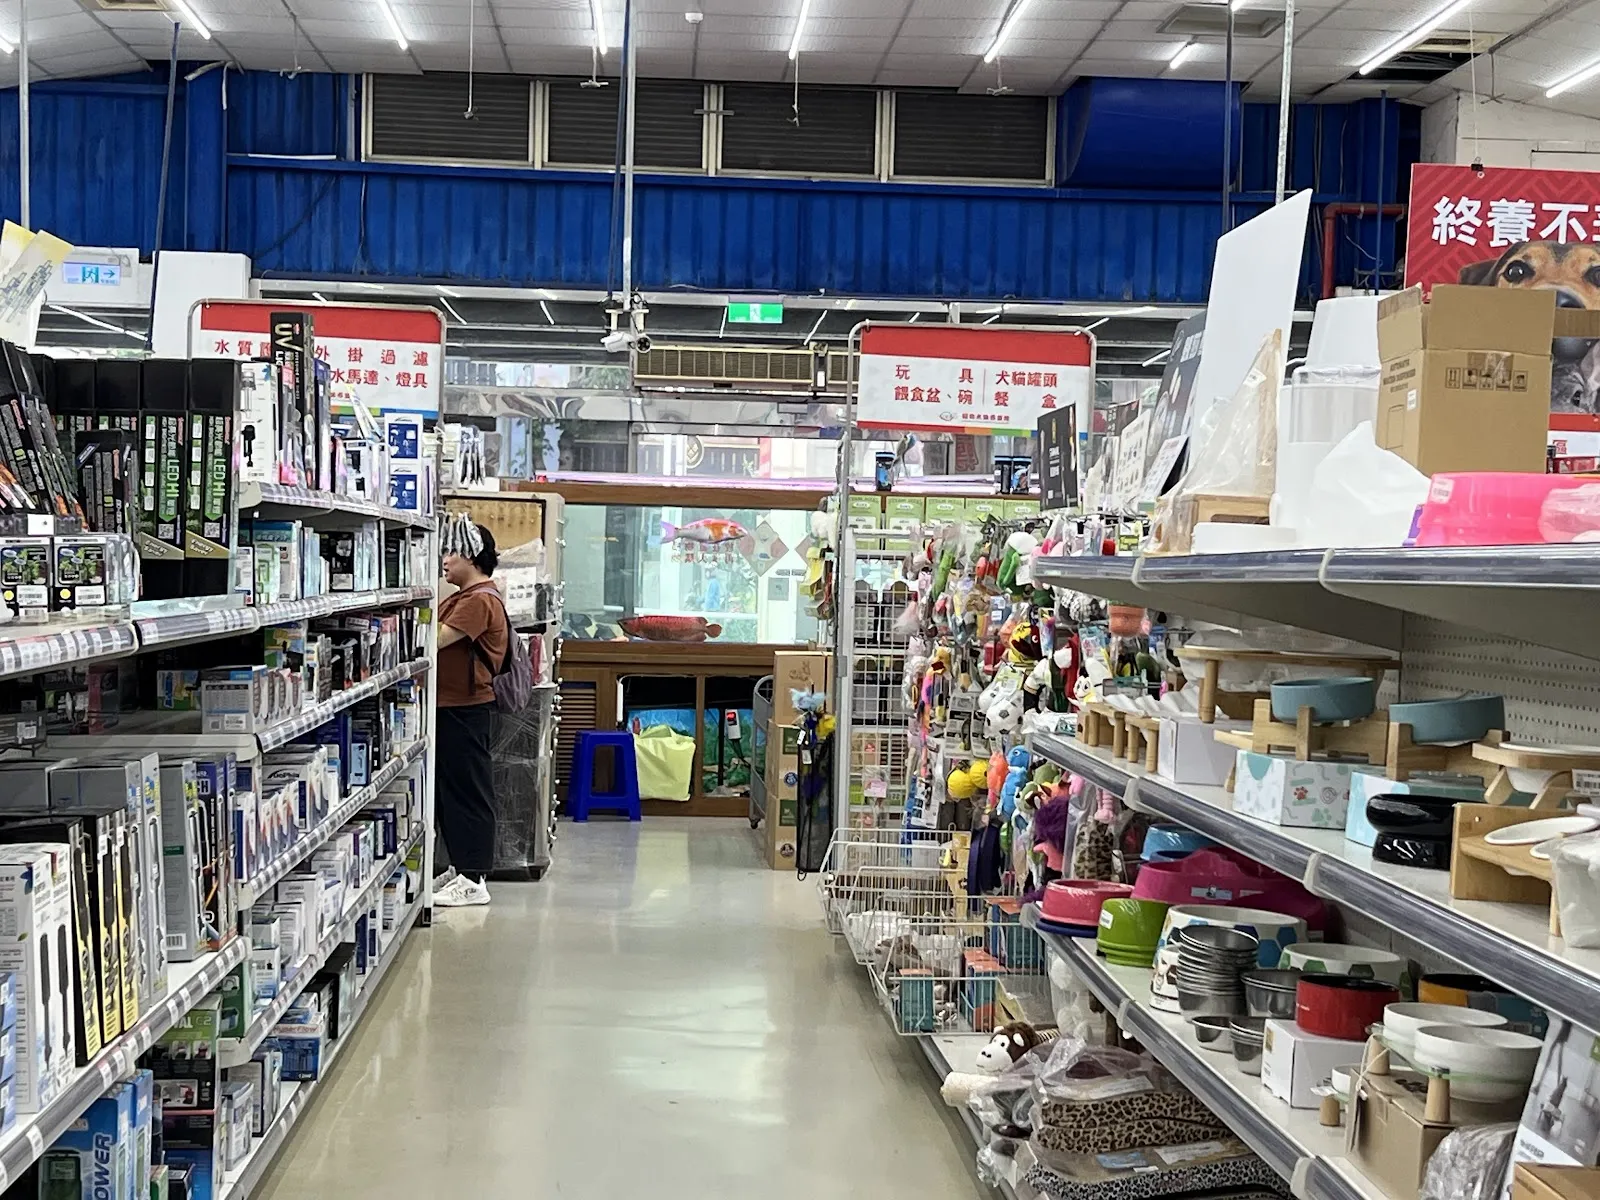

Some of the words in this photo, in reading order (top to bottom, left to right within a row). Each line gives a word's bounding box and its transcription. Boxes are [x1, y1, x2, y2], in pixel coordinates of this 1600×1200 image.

[1431, 196, 1600, 247] 終養不
[275, 323, 303, 352] UV
[315, 345, 428, 366] 外掛過濾
[995, 370, 1058, 388] 犬貓罐頭
[167, 460, 180, 481] LED
[213, 459, 226, 480] LED
[166, 483, 179, 497] HI
[212, 482, 225, 496] HI
